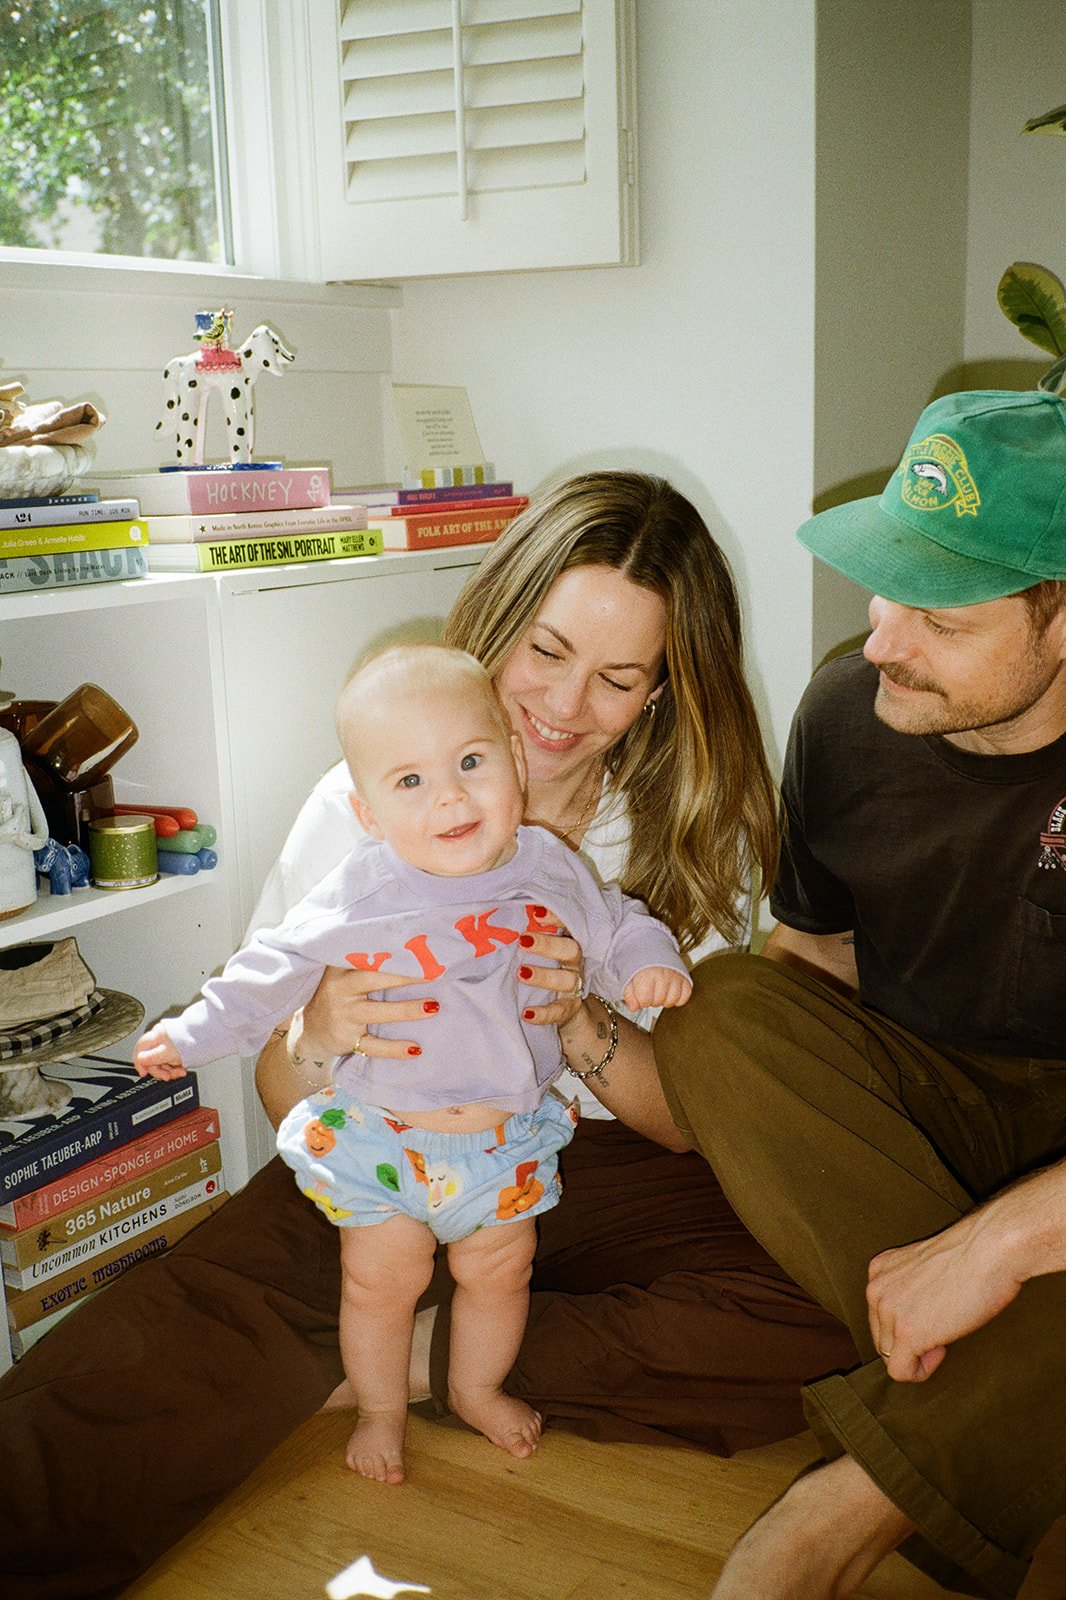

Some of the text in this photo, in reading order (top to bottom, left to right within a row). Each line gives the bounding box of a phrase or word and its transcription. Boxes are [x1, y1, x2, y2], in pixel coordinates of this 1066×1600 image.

[206, 478, 292, 504] HOCKNEY
[954, 469, 975, 502] CLUB
[418, 518, 513, 538] FOLK ART OF THE AM
[209, 537, 335, 565] THE ART OF THE SNL PORTRAIT
[4, 1160, 40, 1190] SOPHIE
[40, 1129, 103, 1171] TAEUBER-ARP
[153, 1146, 164, 1160] at
[167, 1130, 198, 1152] HOME
[65, 1187, 151, 1236] 365 Nature
[32, 1237, 96, 1279] Uncommon
[99, 1204, 168, 1246] KITCHENS
[40, 1277, 89, 1312] EXOTIC
